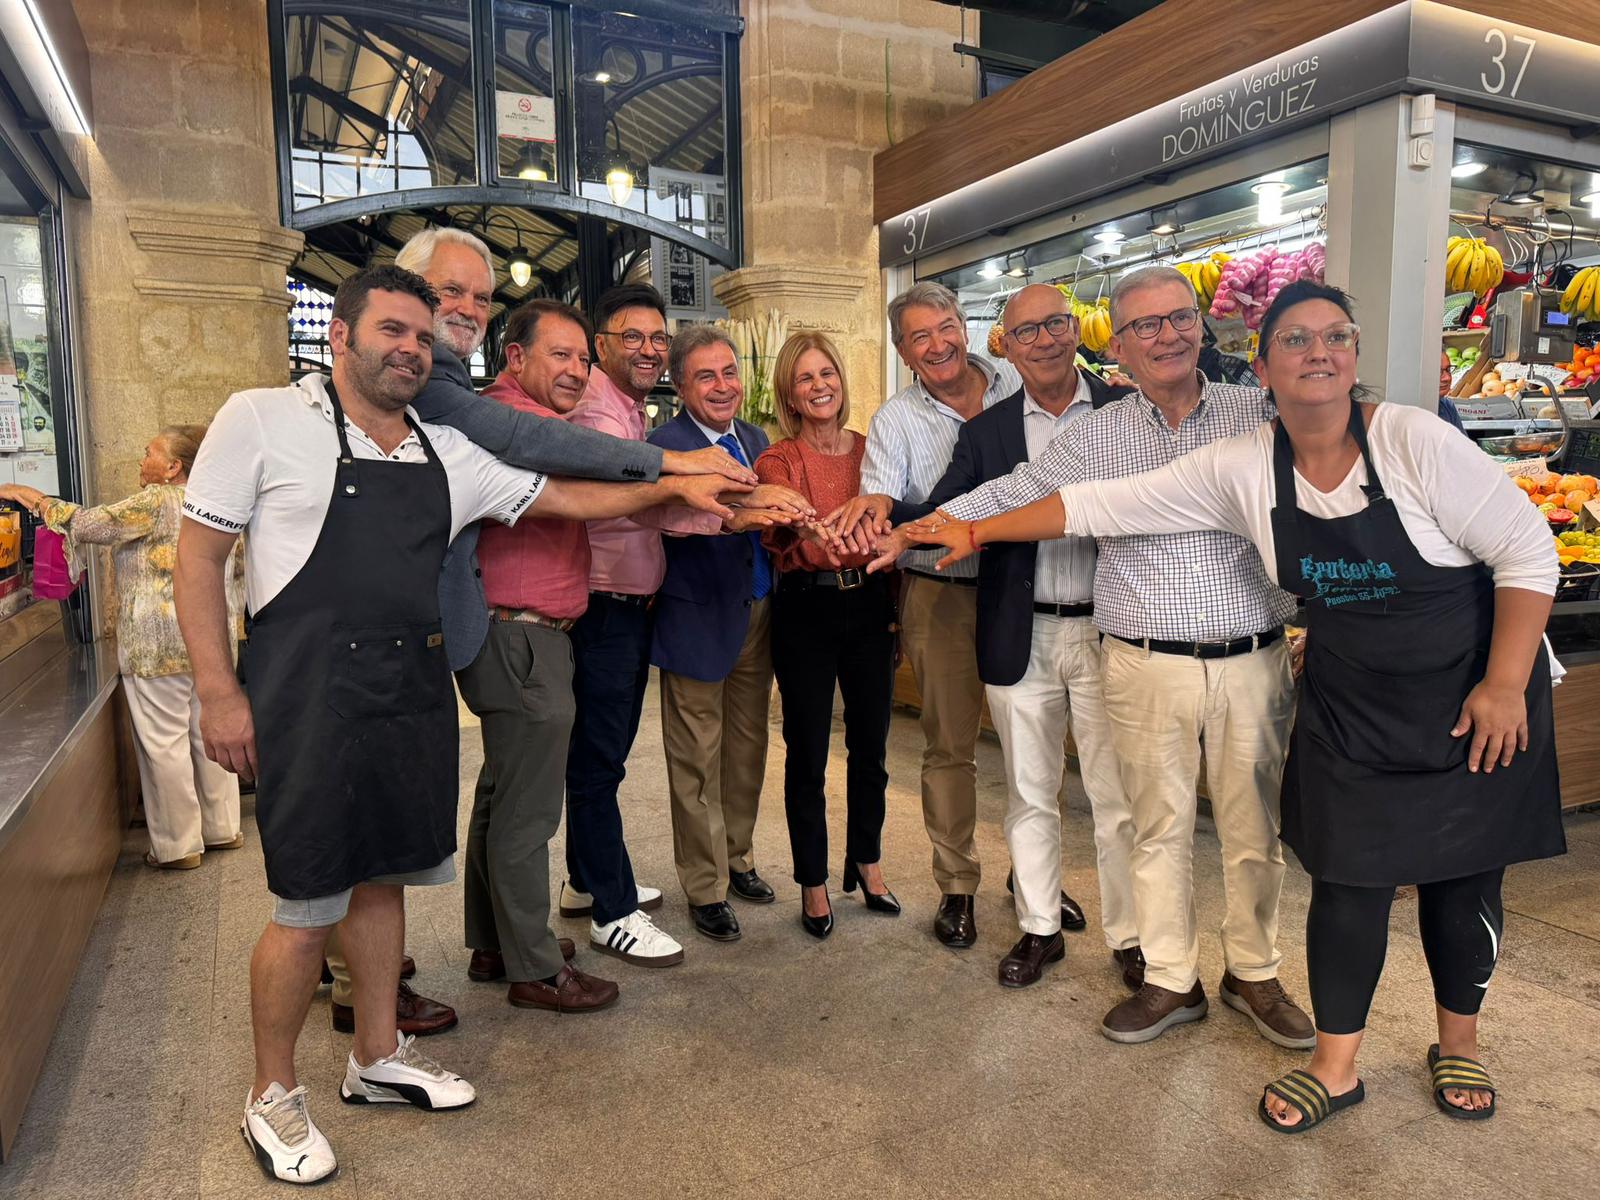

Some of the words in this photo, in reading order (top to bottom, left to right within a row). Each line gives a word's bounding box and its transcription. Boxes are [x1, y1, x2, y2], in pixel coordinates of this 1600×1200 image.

[1179, 93, 1224, 123] Frutas
[1229, 88, 1237, 108] y
[1242, 55, 1319, 96] Verduras
[1481, 28, 1537, 98] 37
[1162, 78, 1317, 163] DOMÍNGUEZ
[903, 208, 931, 255] 37
[511, 495, 531, 513] KARL
